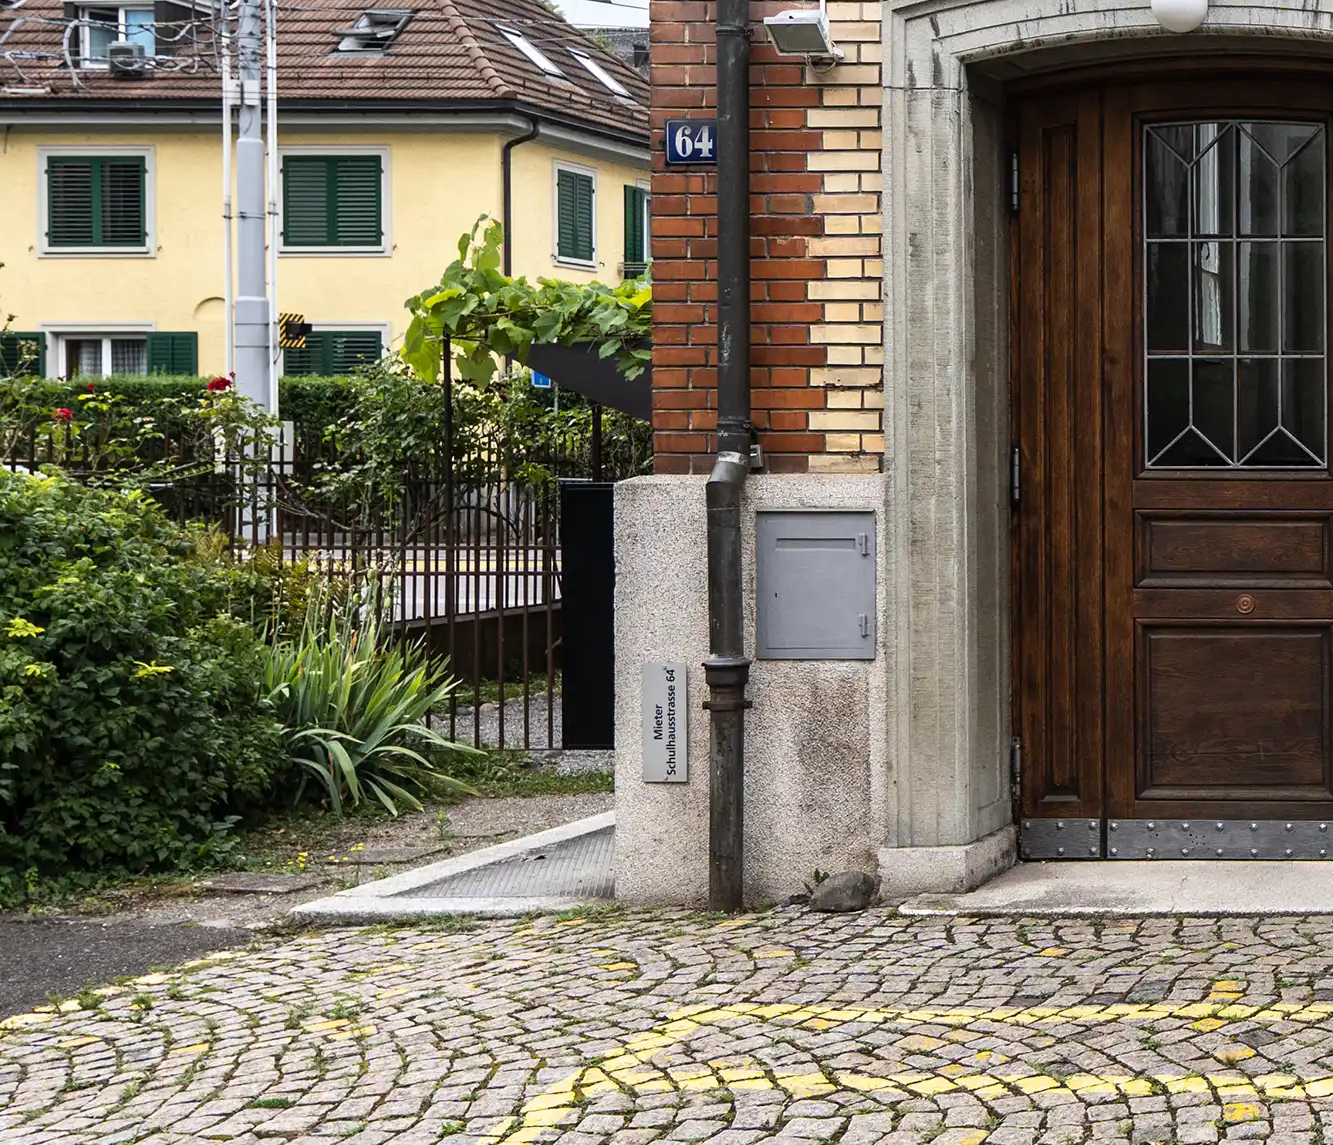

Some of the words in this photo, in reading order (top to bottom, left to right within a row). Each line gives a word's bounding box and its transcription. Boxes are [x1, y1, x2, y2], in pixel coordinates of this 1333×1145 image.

[675, 125, 713, 158] 64
[666, 669, 676, 682] 64
[653, 704, 663, 740] Mieter
[666, 684, 676, 776] Schulhausstrasse
